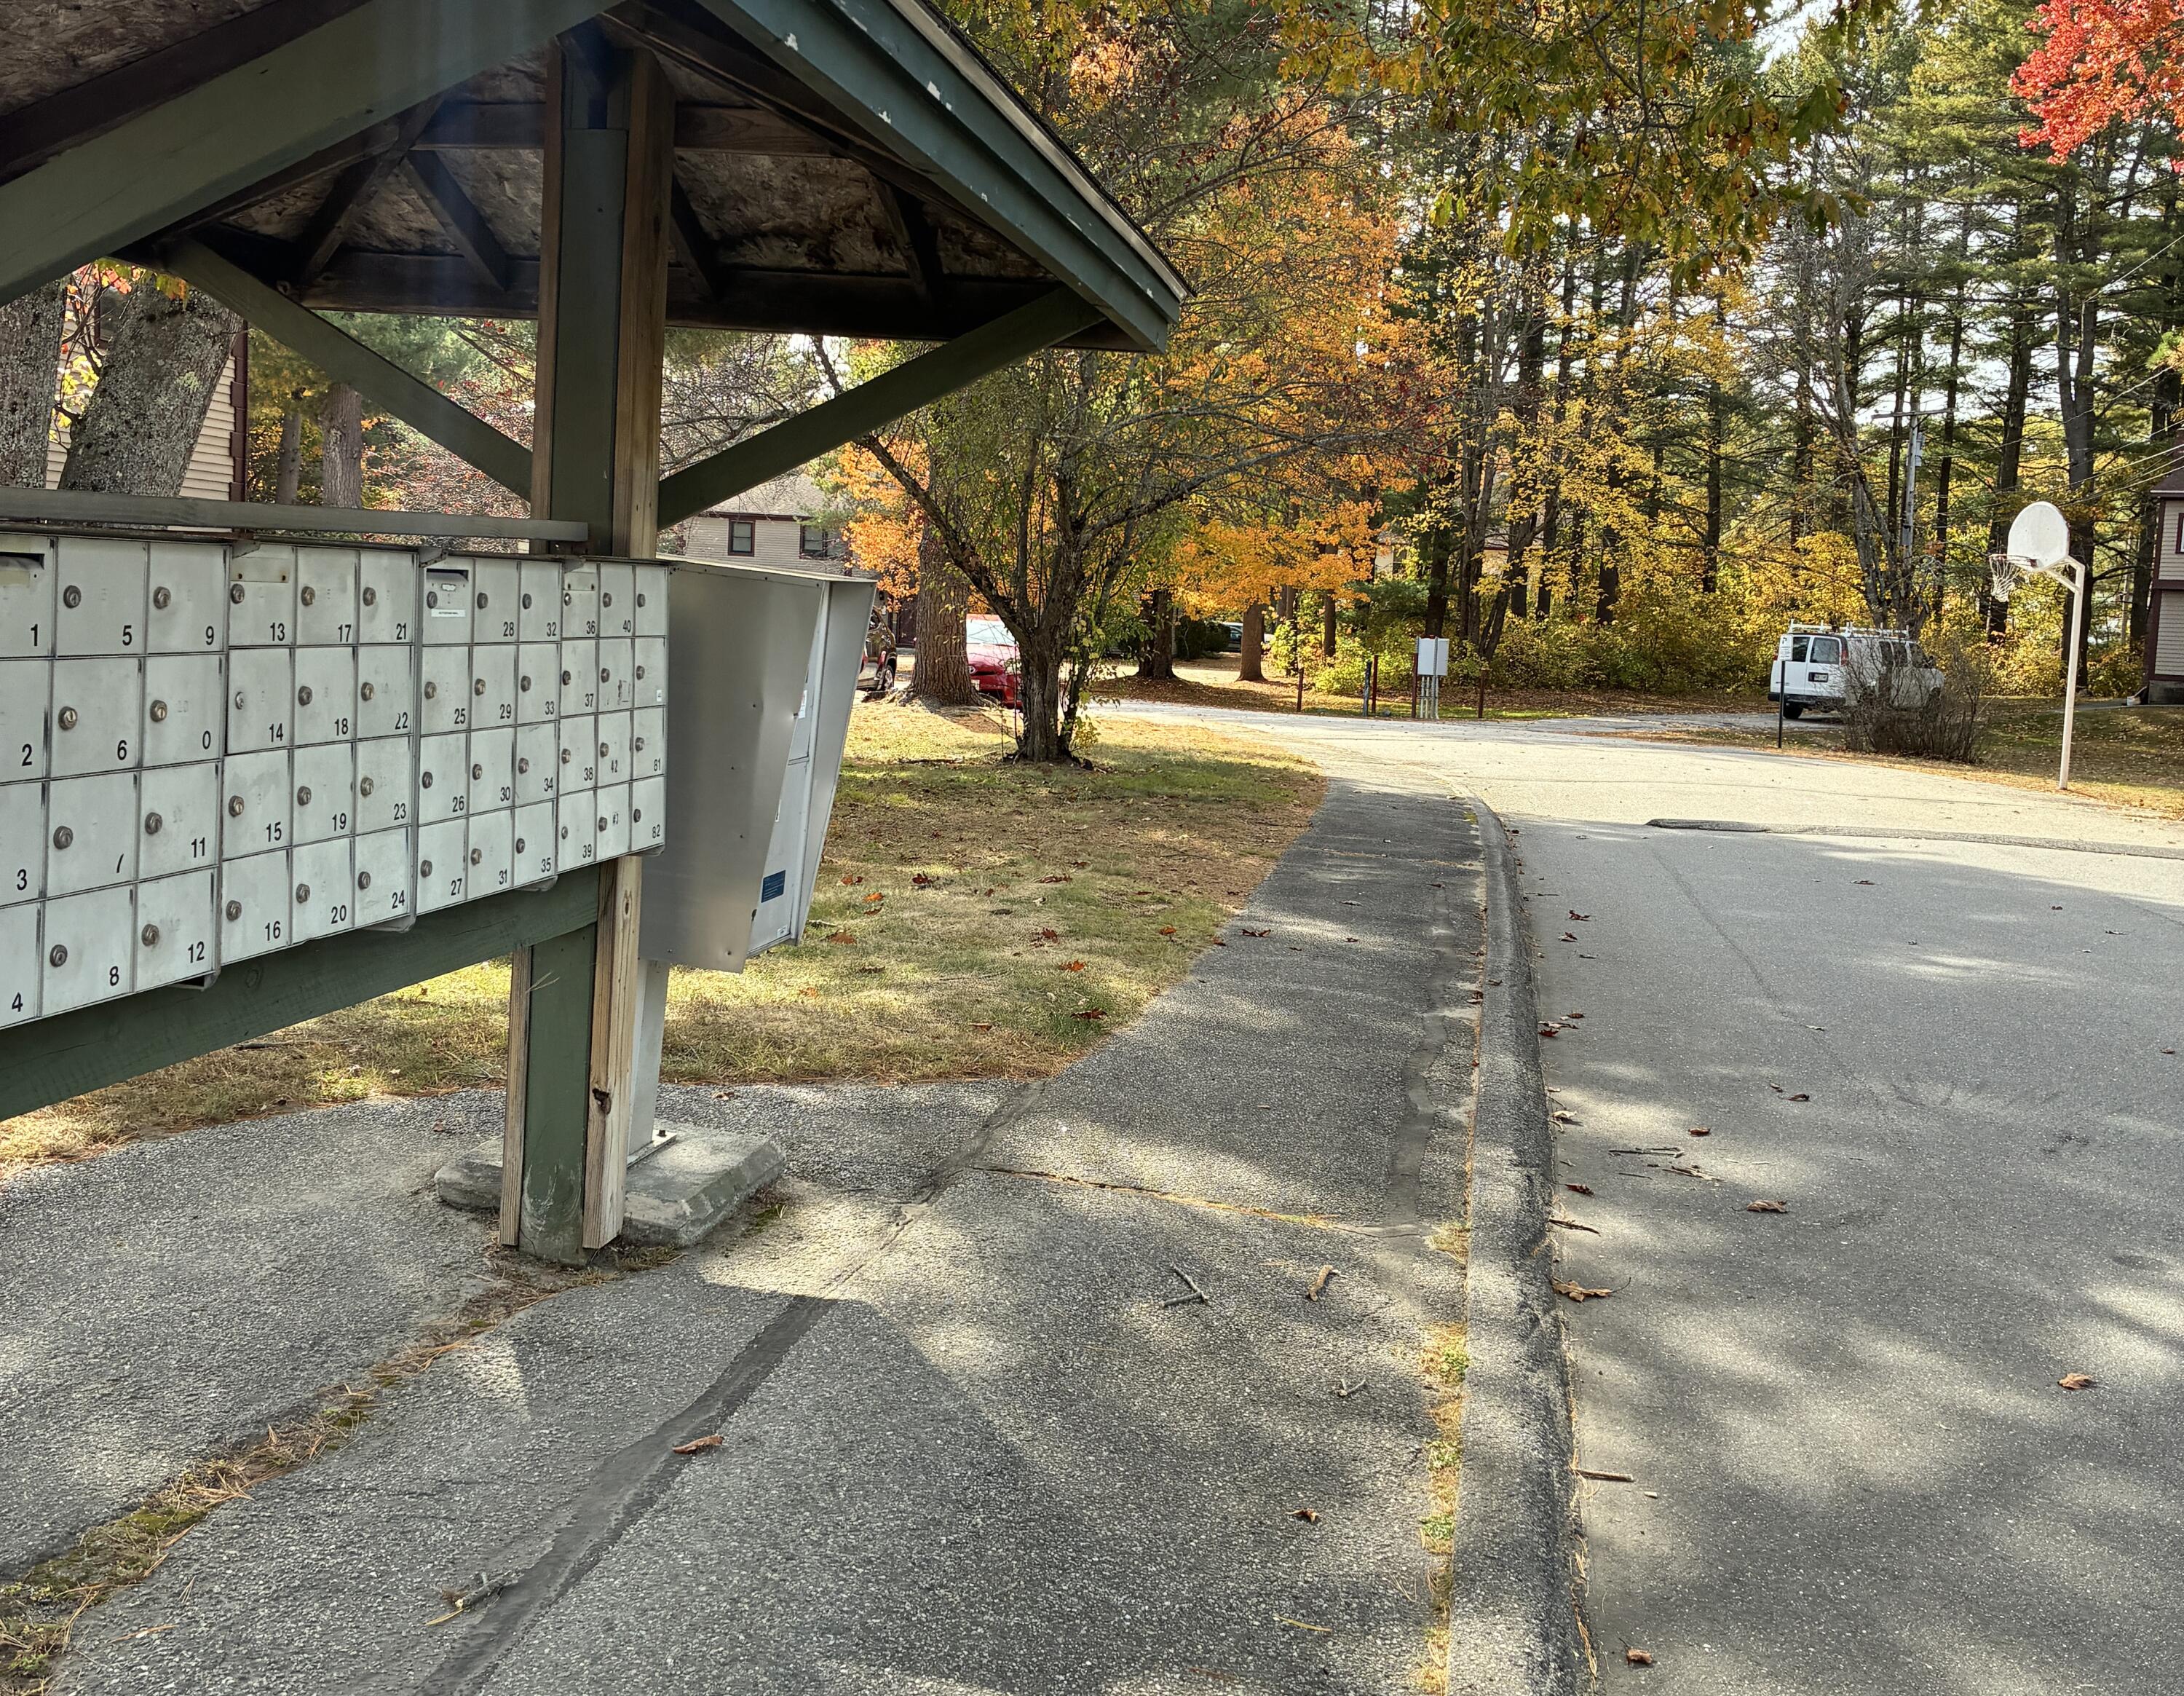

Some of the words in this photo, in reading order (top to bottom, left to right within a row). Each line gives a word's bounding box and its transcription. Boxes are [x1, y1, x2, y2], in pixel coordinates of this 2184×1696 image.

[270, 623, 285, 641] 13
[339, 625, 351, 642] 17
[397, 623, 406, 640] 21
[503, 622, 514, 636] 28
[547, 622, 556, 636] 32
[587, 620, 596, 634] 36
[623, 620, 631, 632] 40
[31, 624, 38, 646] 1
[122, 626, 132, 645] 5
[206, 626, 214, 645] 9
[545, 701, 554, 715] 33
[585, 693, 593, 707] 37
[454, 709, 465, 724] 25
[500, 704, 511, 719] 29
[335, 718, 348, 735] 18
[395, 712, 408, 730] 22
[269, 723, 283, 742] 14
[22, 744, 32, 766] 2
[117, 740, 127, 760] 6
[584, 768, 593, 781] 38
[545, 777, 553, 792] 34
[500, 786, 510, 802] 30
[394, 803, 405, 820] 23
[453, 796, 464, 812] 26
[332, 813, 346, 831] 19
[266, 821, 281, 842] 15
[652, 824, 660, 838] 82
[191, 837, 205, 858] 11
[582, 844, 592, 858] 39
[542, 858, 550, 872] 35
[17, 869, 27, 890] 3
[499, 869, 507, 885] 31
[451, 878, 462, 896] 27
[392, 890, 405, 909] 24
[331, 905, 347, 924] 20
[265, 921, 280, 941] 16
[188, 942, 204, 963] 12
[110, 966, 119, 986] 8
[12, 993, 23, 1011] 4
